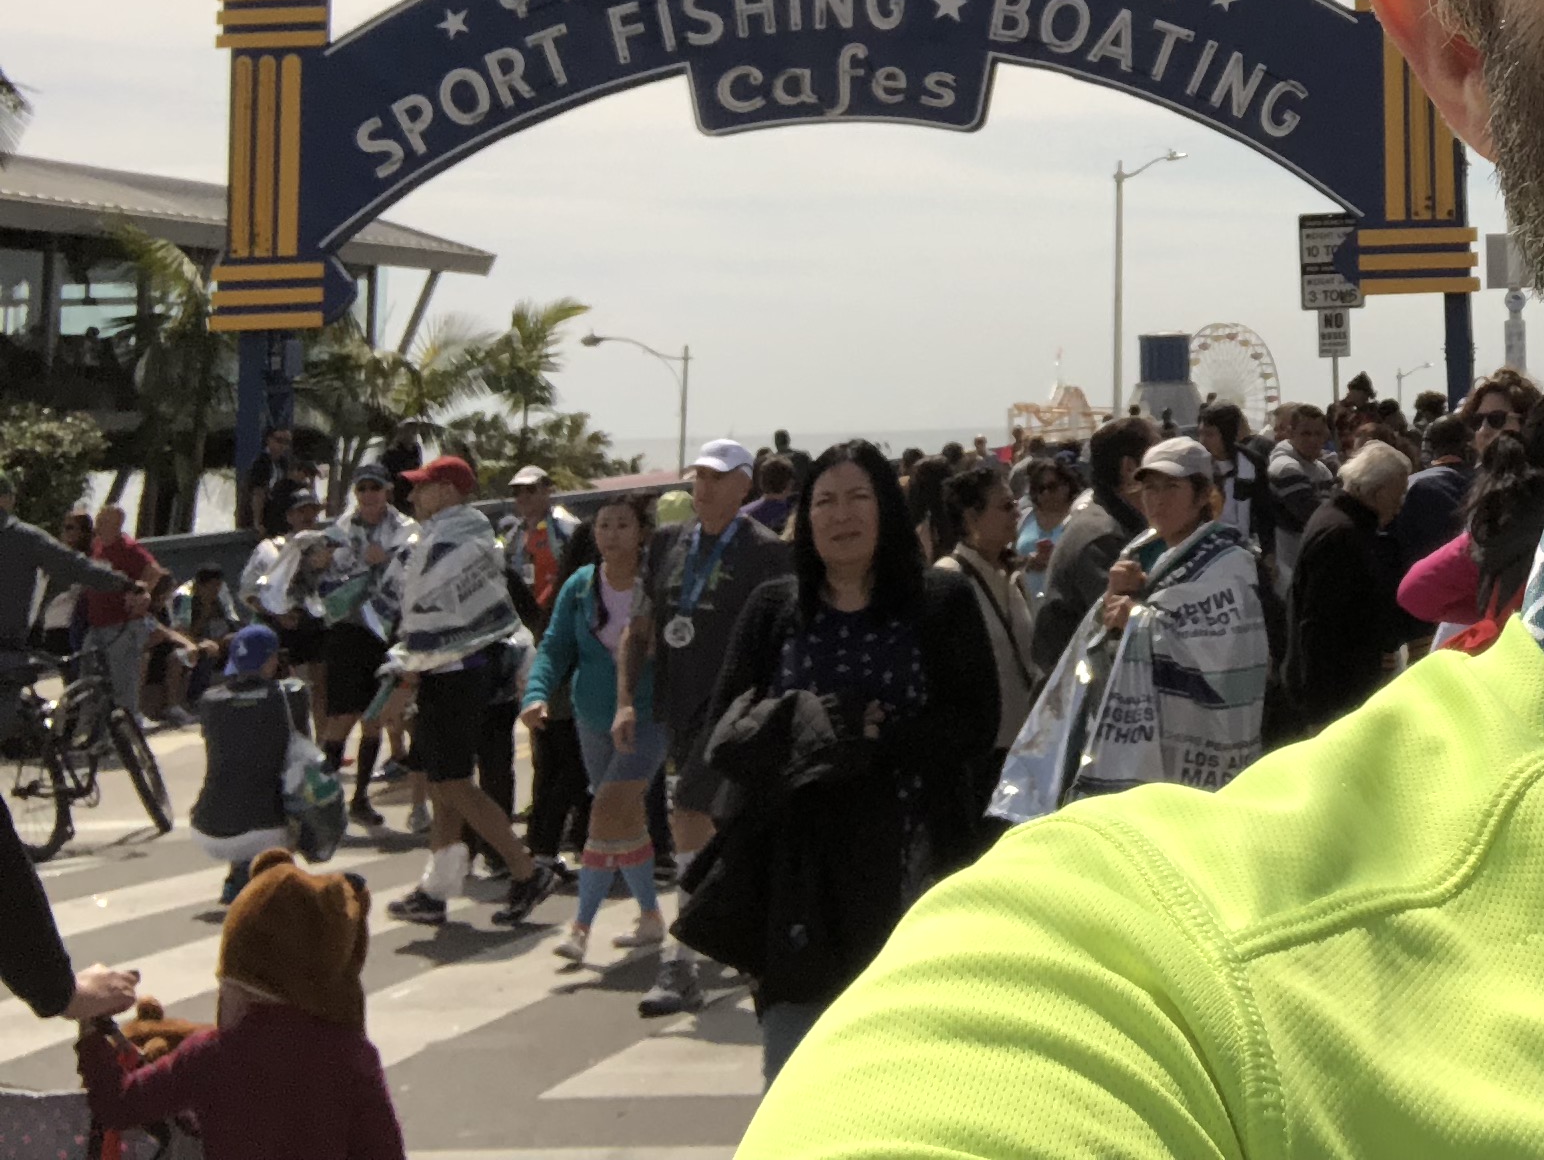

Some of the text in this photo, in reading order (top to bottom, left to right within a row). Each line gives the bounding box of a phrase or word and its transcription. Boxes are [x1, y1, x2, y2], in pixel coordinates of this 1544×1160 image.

[355, 23, 568, 180] SPORT
[1305, 245, 1320, 258] 10
[1323, 312, 1345, 329] NO
